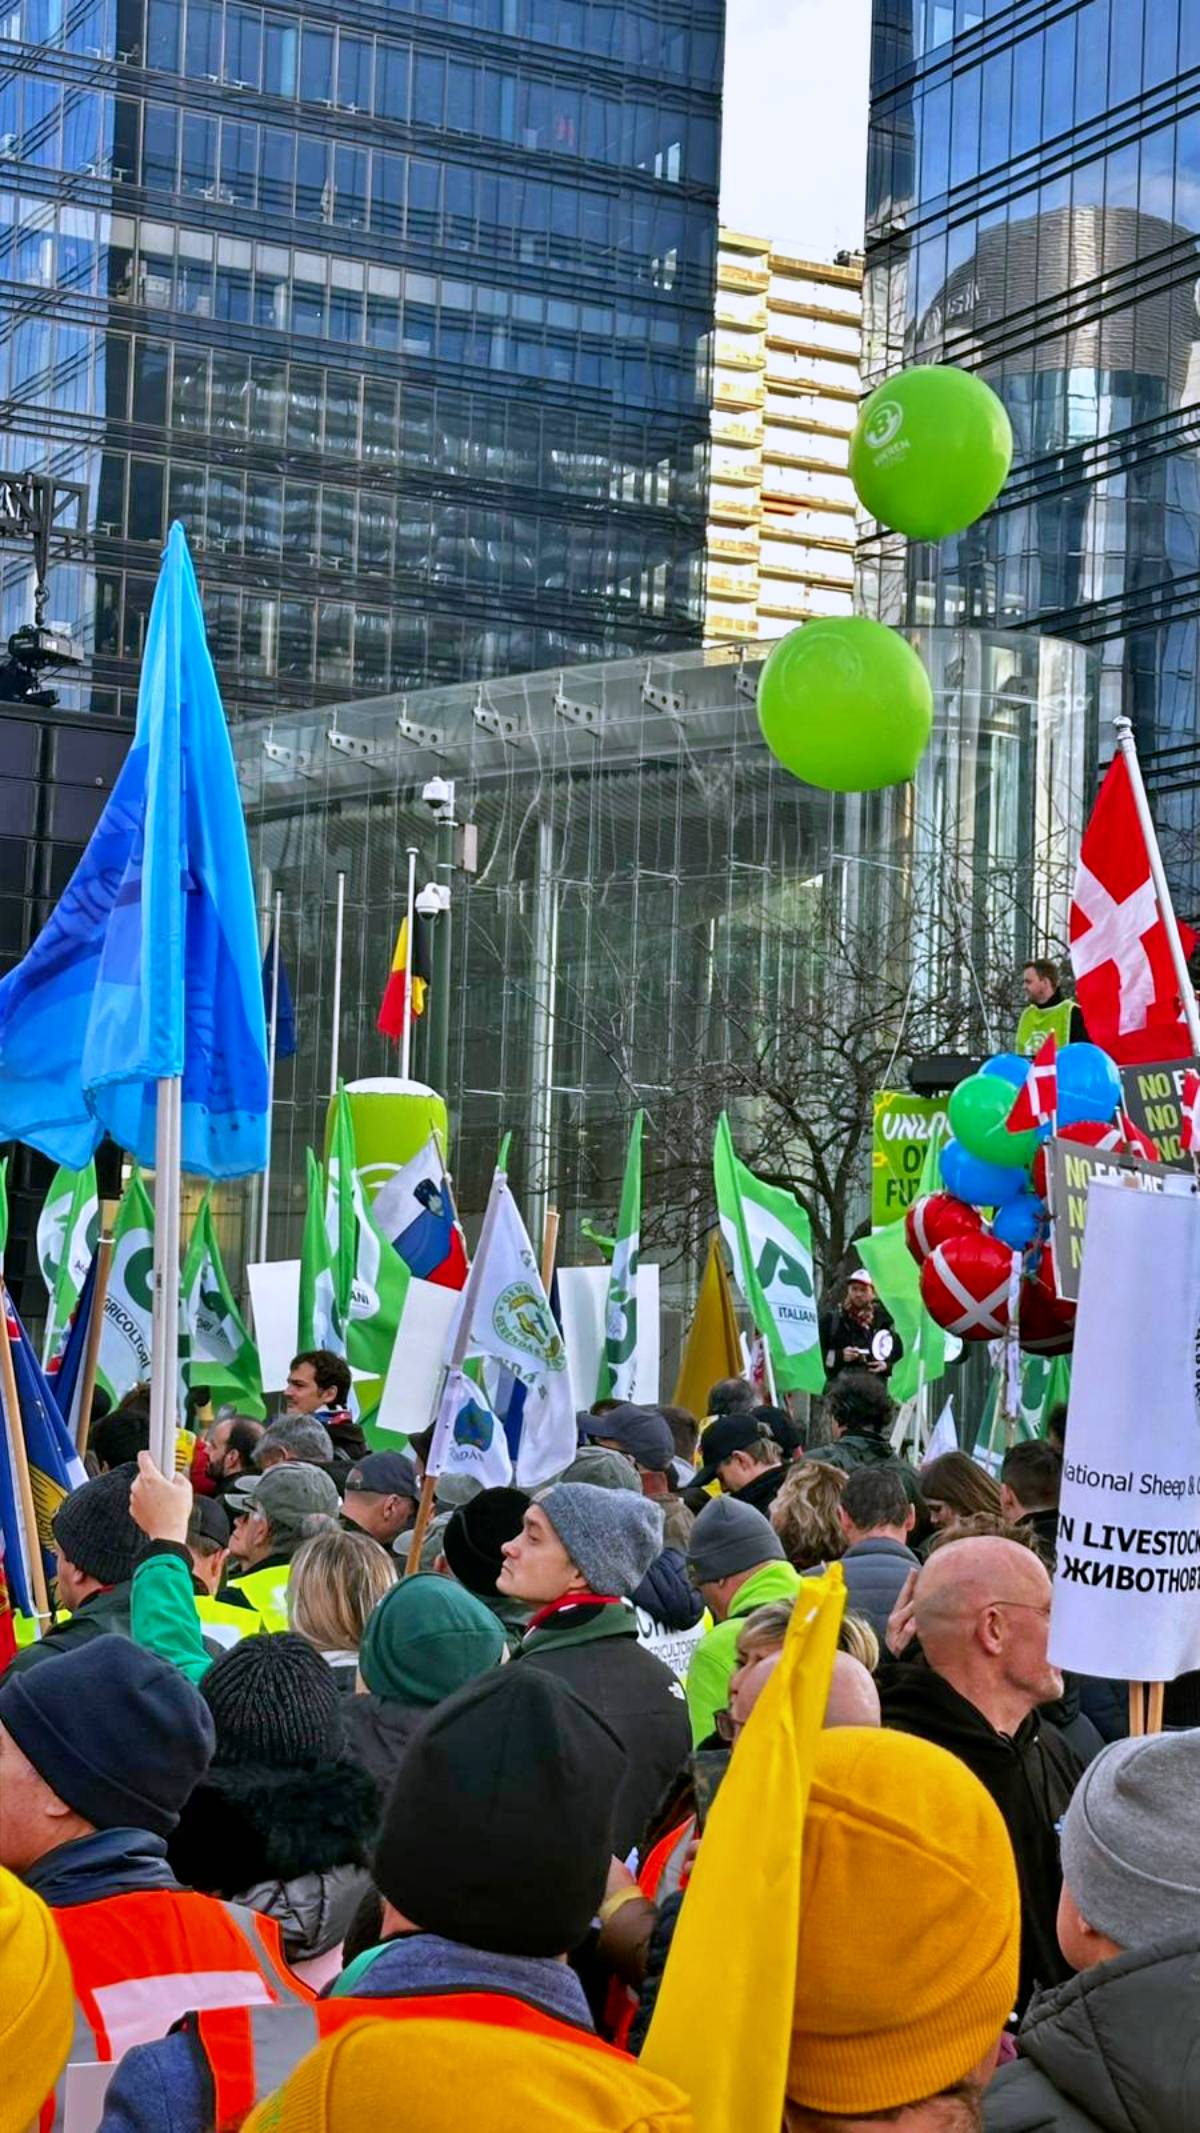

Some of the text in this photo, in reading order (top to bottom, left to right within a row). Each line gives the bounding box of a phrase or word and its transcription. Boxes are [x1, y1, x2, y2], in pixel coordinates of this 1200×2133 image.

[1137, 1069, 1185, 1101] NO F
[882, 1110, 955, 1141] UNLO
[1144, 1104, 1179, 1132] NO
[1152, 1134, 1186, 1162] NO
[1064, 1153, 1092, 1190] NO
[103, 1296, 151, 1370] GRICOLTORI
[1139, 1473, 1186, 1500] Sheep
